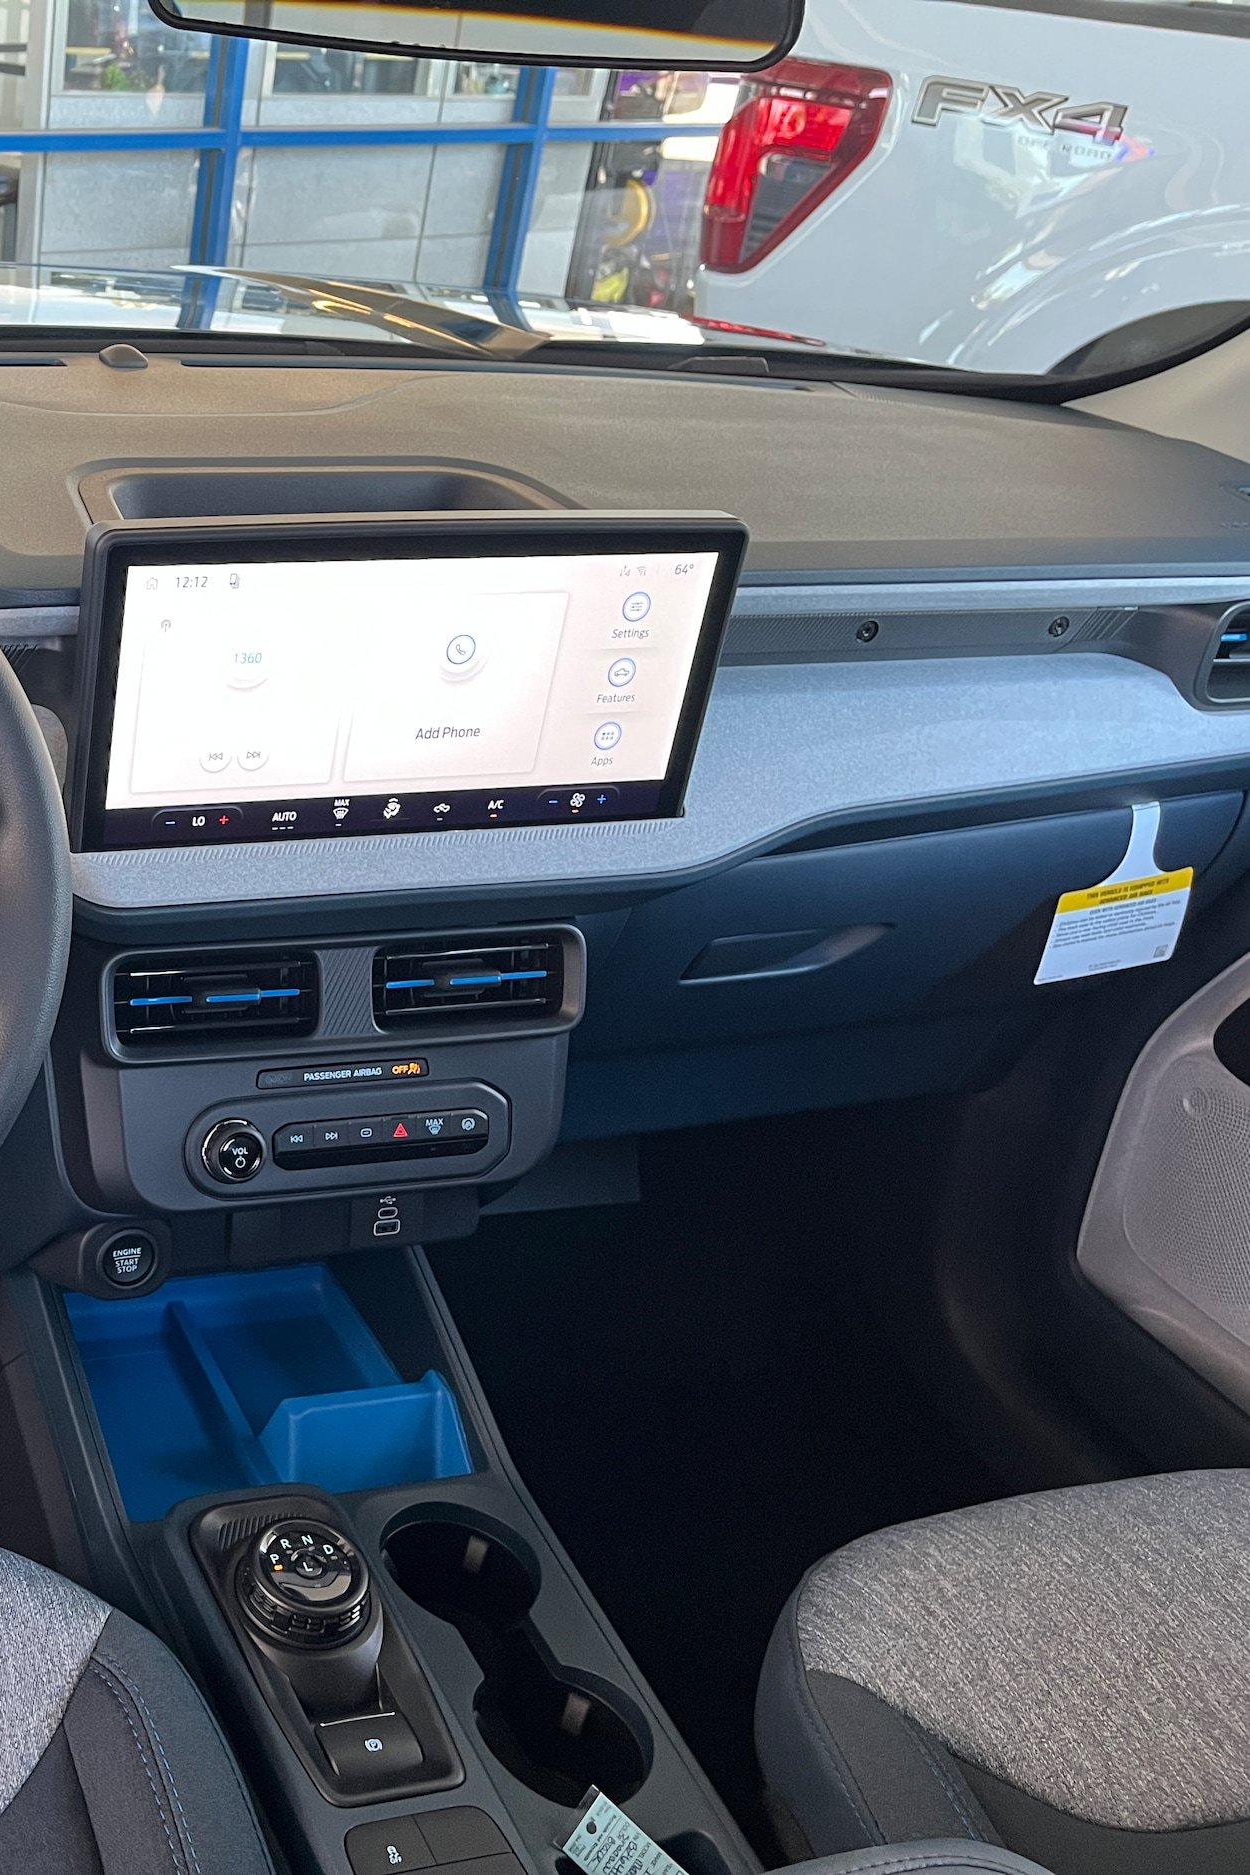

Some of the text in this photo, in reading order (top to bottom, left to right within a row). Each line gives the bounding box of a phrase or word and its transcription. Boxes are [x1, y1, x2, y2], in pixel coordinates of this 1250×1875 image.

[911, 75, 1128, 144] FX4
[175, 575, 208, 589] 12:12
[611, 627, 650, 640] Settings
[232, 651, 263, 665] 1360
[596, 690, 636, 704] Features
[415, 724, 481, 741] Add Phone
[590, 754, 614, 768] Apps
[334, 798, 350, 807] MAX
[487, 799, 505, 811] A/C
[192, 816, 206, 828] LO
[272, 811, 297, 824] AUTO
[303, 1064, 409, 1081] PASSENGER AIRBAG OFF
[425, 1118, 444, 1127] MAX
[232, 1147, 248, 1156] VOL
[113, 1247, 142, 1257] ENGINE
[115, 1258, 139, 1267] START
[117, 1265, 138, 1274] STOP
[269, 1535, 334, 1564] P R N D
[302, 1561, 313, 1572] L
